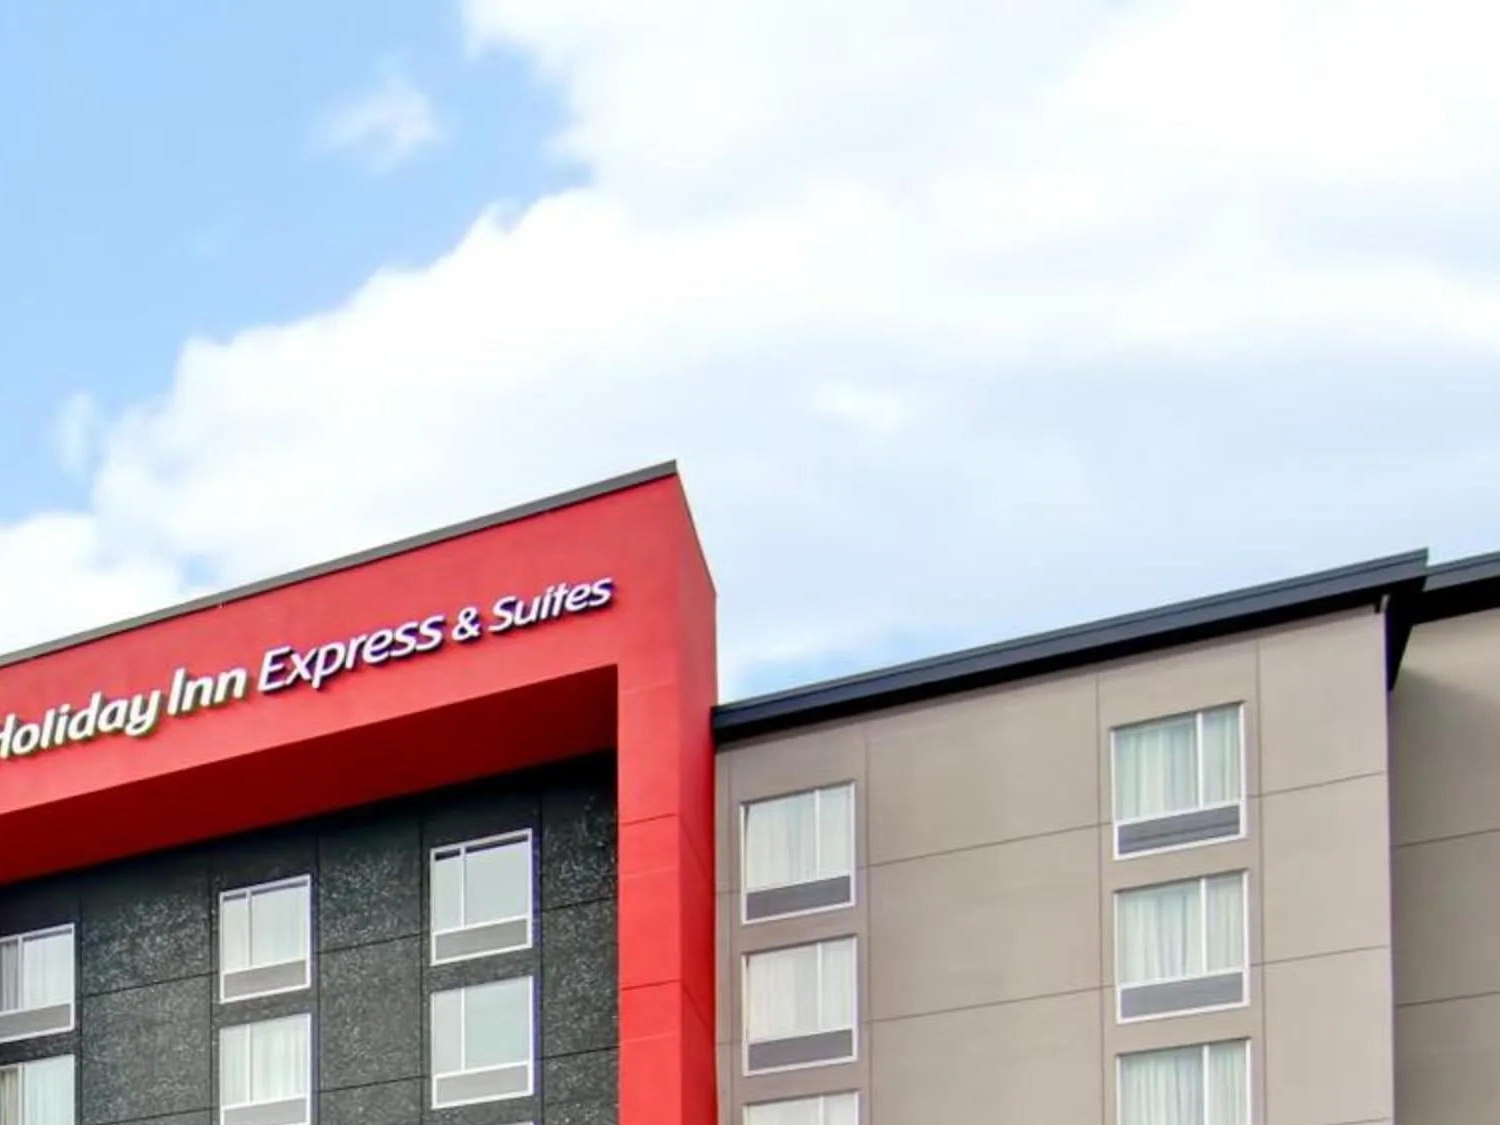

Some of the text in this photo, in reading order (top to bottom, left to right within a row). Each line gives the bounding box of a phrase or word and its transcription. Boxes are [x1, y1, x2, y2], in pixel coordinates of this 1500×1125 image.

[167, 667, 247, 715] Inn
[258, 614, 445, 690] Express
[451, 606, 480, 641] &
[488, 577, 612, 633] Suites
